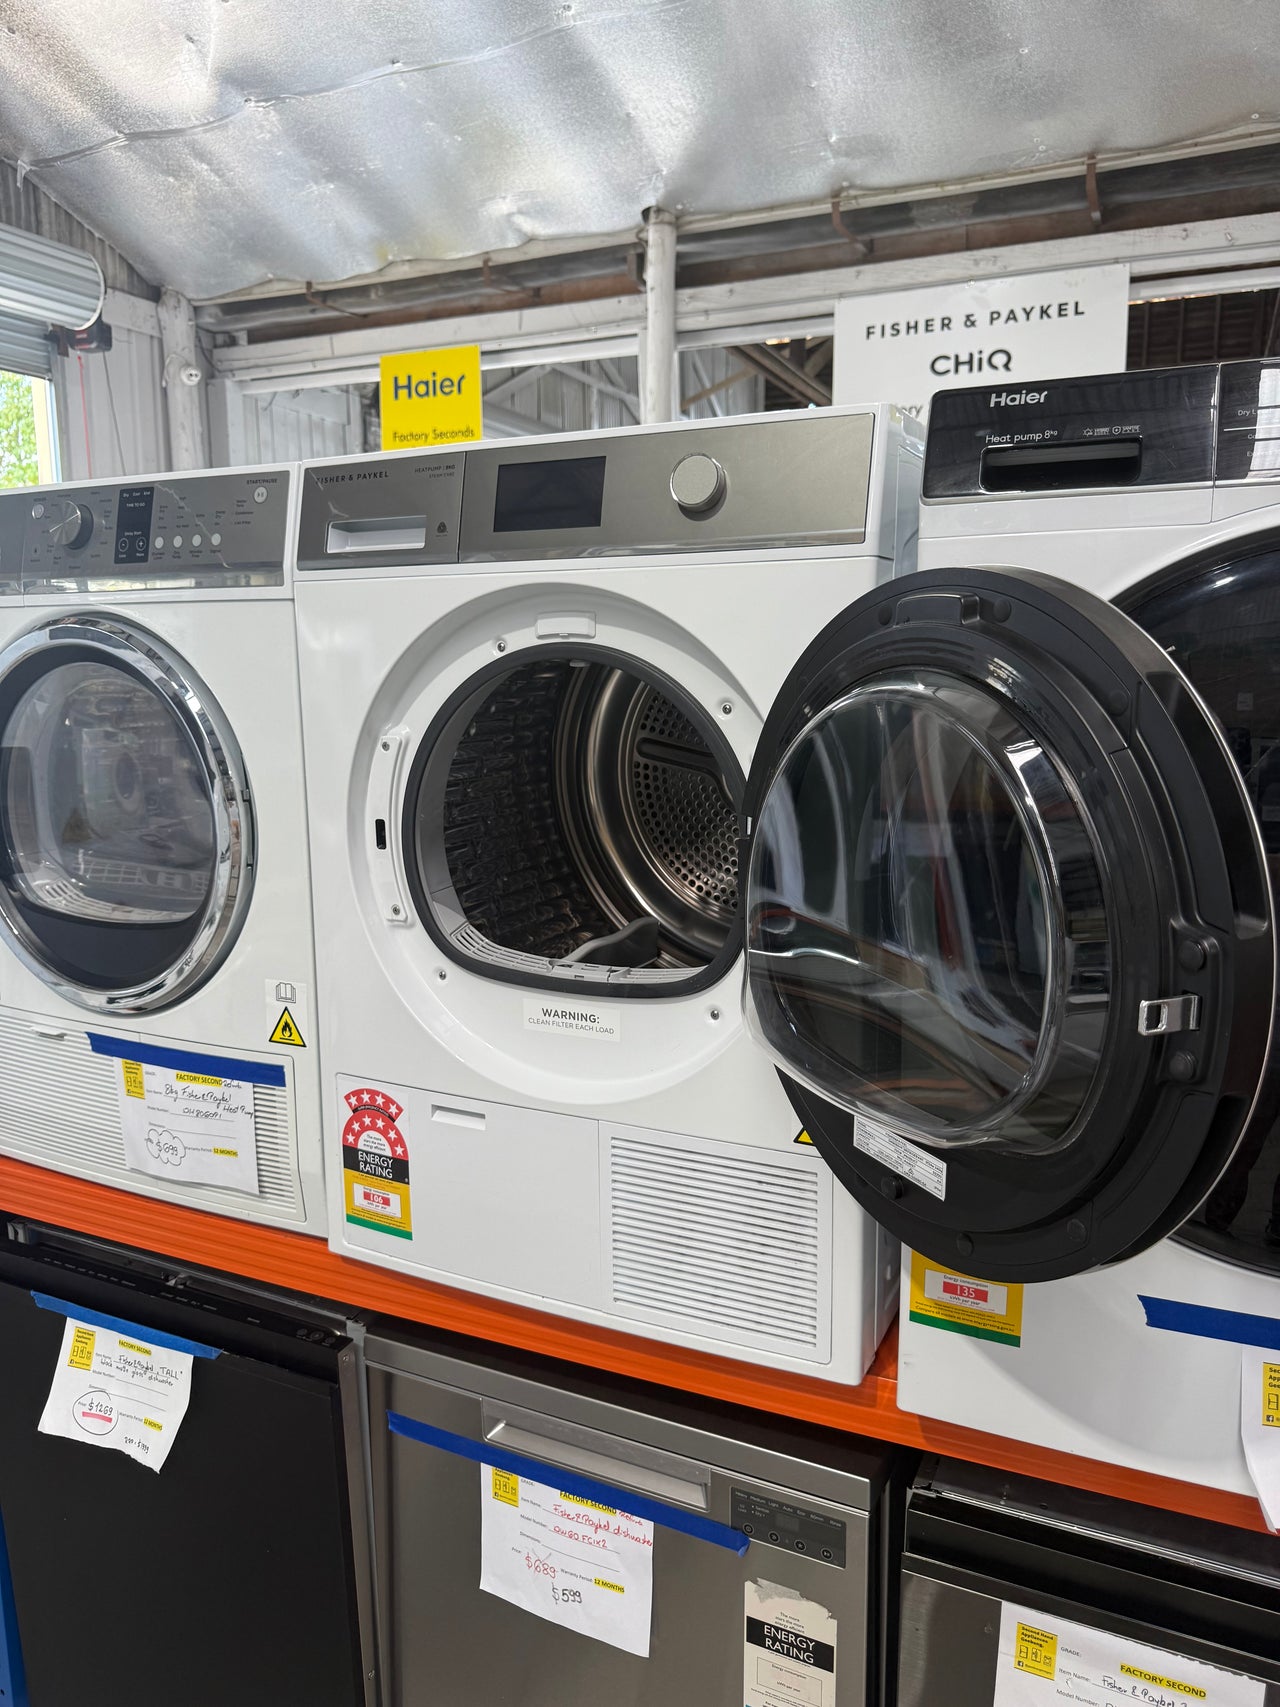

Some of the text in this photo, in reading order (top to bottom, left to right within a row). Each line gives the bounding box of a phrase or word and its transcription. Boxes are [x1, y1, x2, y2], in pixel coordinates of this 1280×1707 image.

[866, 301, 1085, 340] FISHER & PAYKEL
[930, 349, 1013, 376] CHiQ
[393, 371, 466, 401] Haier
[989, 389, 1048, 408] Haier
[392, 425, 474, 443] Factory Seconds
[985, 434, 1011, 443] Heat
[1013, 432, 1042, 444] pump
[357, 471, 389, 480] PAYKEL
[541, 1007, 600, 1024] WARNING:
[528, 1017, 615, 1035] CLEAN FILTER EACH LOAD
[176, 1073, 200, 1083] FACTORY
[201, 1076, 222, 1086] SECOND
[358, 1151, 393, 1168] ENERGY
[360, 1162, 392, 1178] RATING
[370, 1194, 383, 1203] 106
[957, 1284, 975, 1298] 135
[560, 1491, 617, 1515] FACTORY SECOND
[525, 1552, 556, 1579] $689
[551, 1581, 583, 1605] $599
[601, 1580, 625, 1593] MONTHS
[763, 1624, 815, 1651] ENERGY
[765, 1637, 814, 1664] RATING
[1120, 1664, 1206, 1698] FACTORY SECOND
